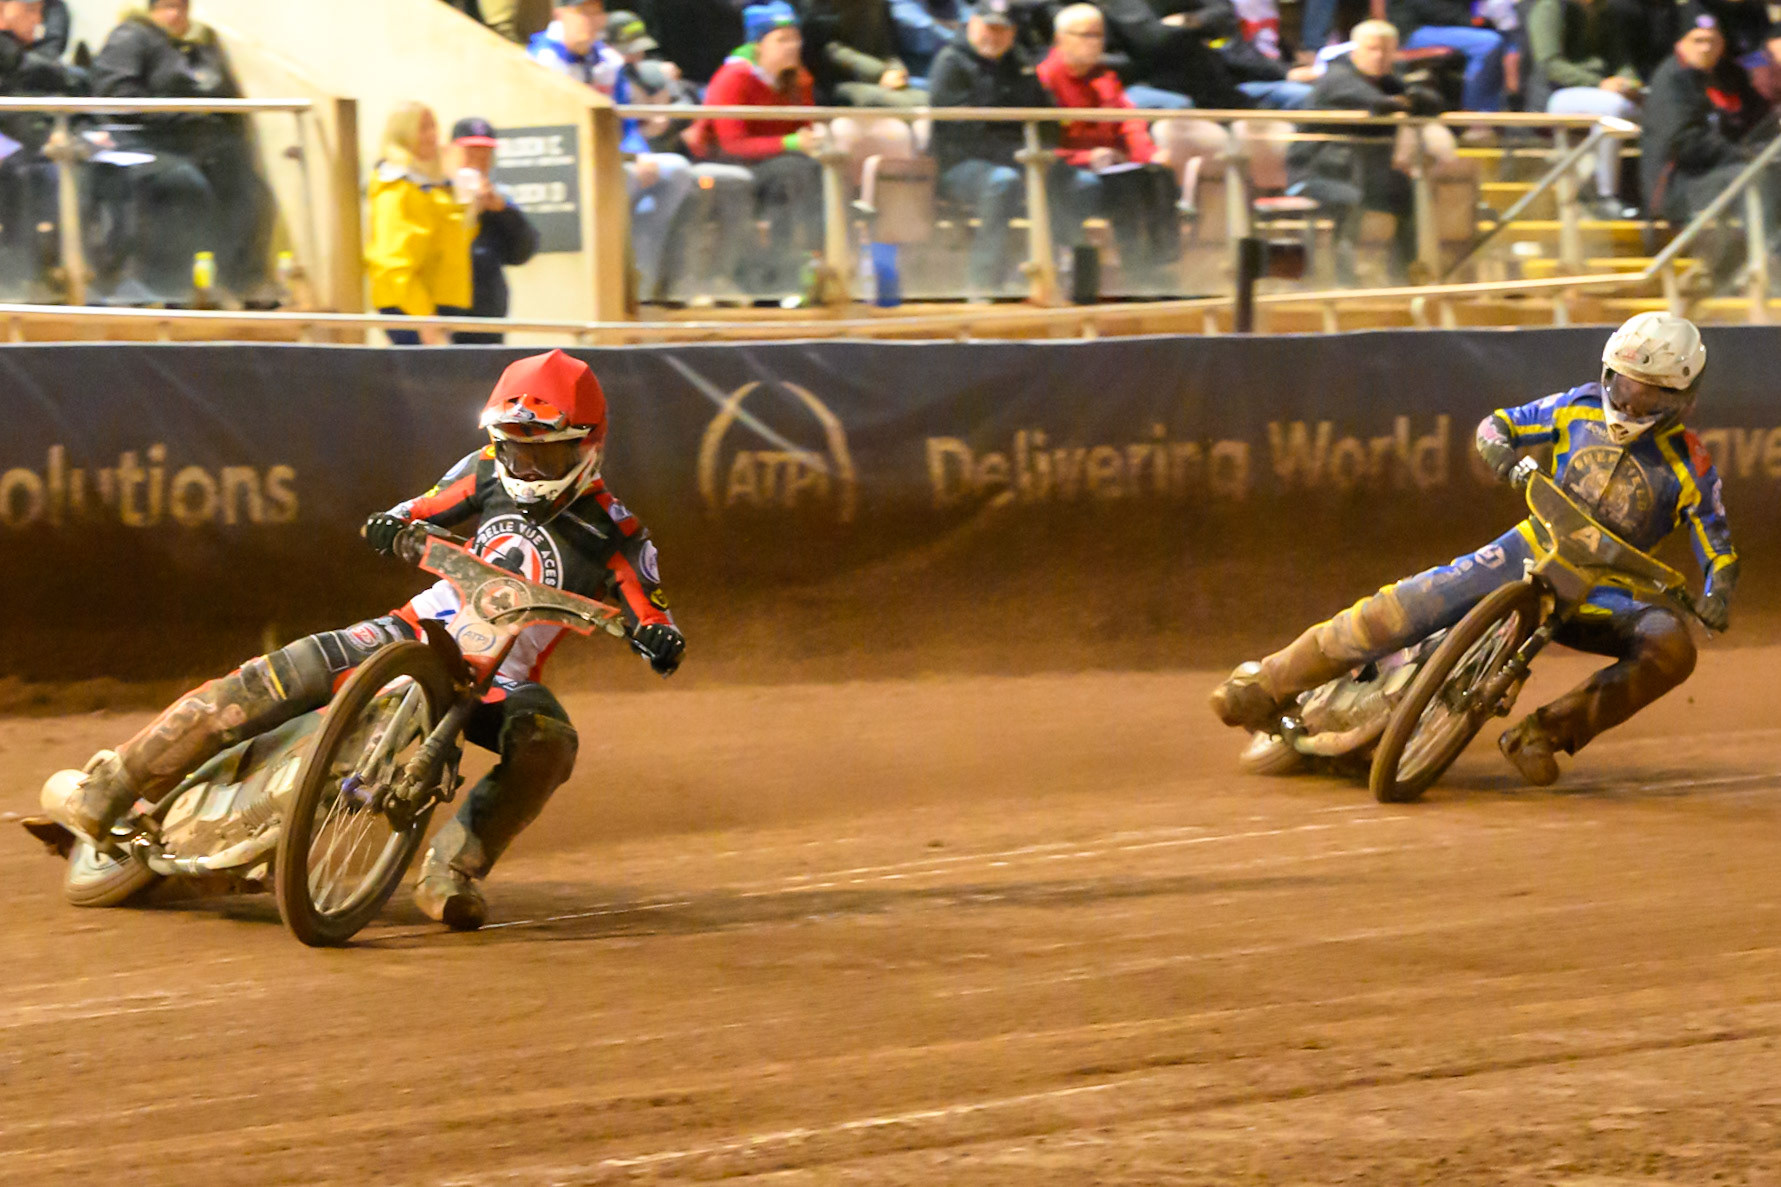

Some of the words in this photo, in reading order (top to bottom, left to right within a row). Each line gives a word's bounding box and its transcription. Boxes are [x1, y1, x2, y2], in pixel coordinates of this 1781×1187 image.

[1268, 414, 1451, 488] World
[480, 521, 514, 544] BELLE
[520, 523, 545, 546] VUE
[540, 550, 557, 586] ACES
